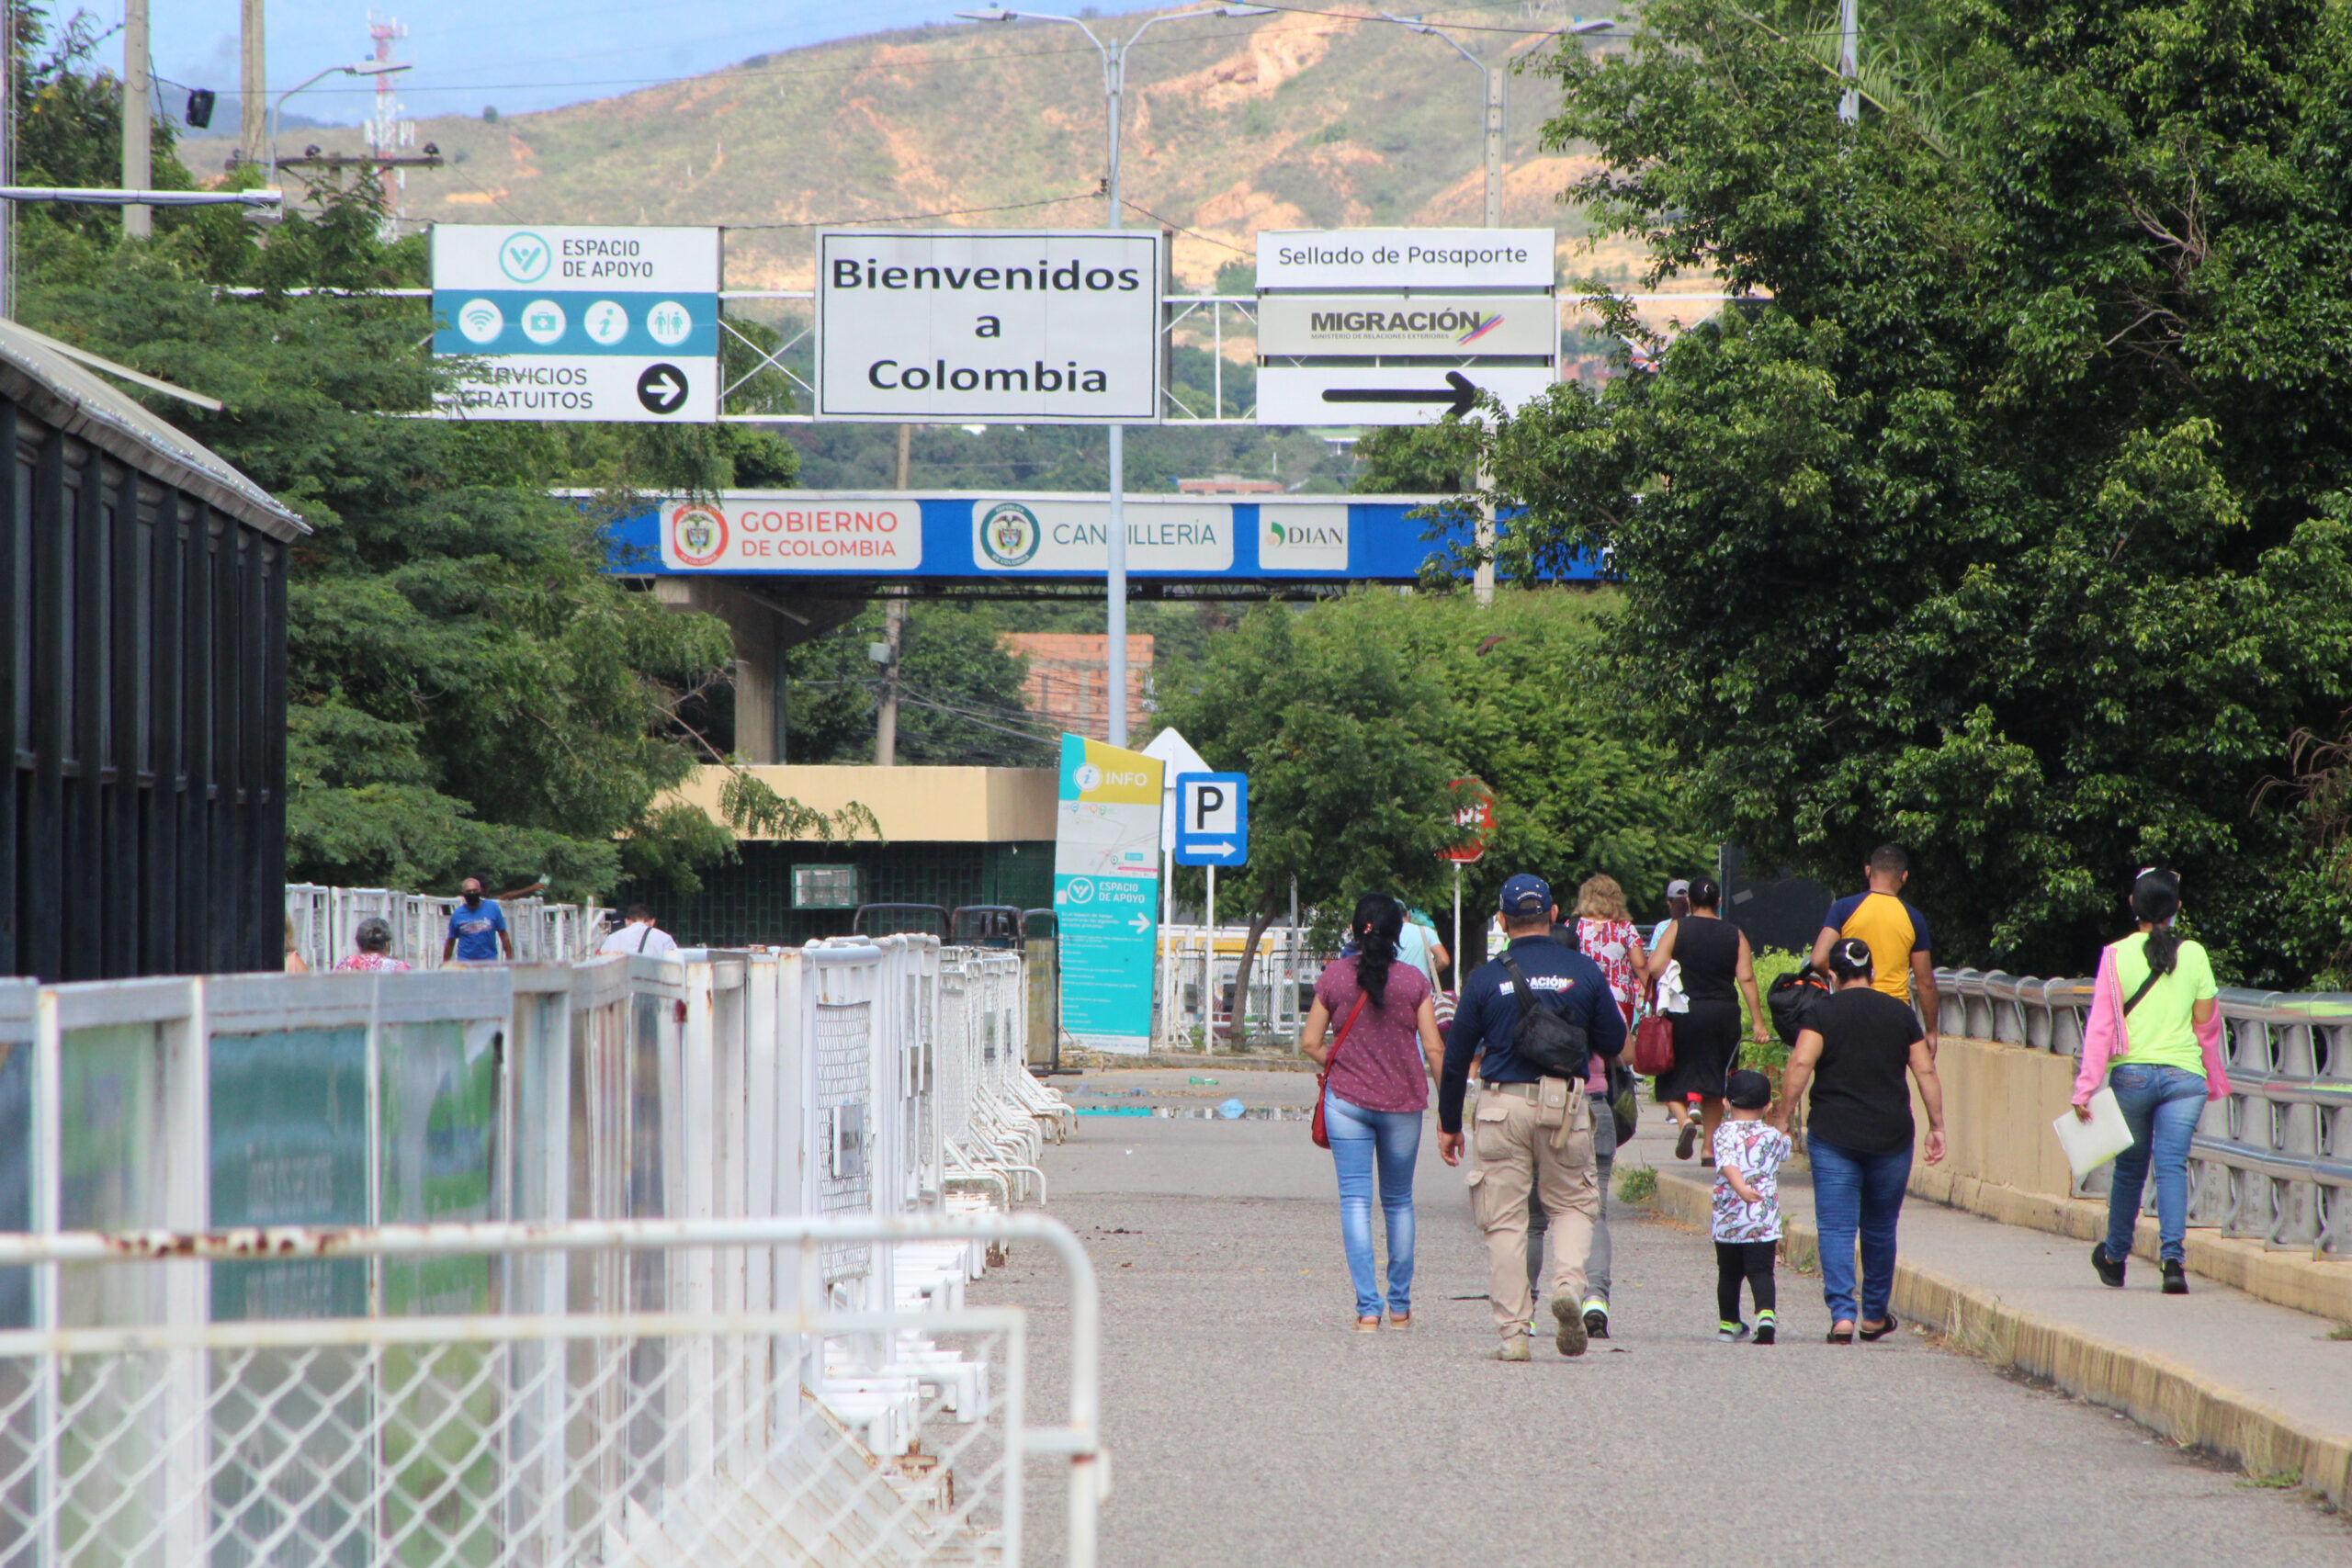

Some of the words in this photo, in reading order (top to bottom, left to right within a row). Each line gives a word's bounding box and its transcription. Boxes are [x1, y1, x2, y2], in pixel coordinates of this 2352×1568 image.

[562, 240, 640, 256] ESPACIO
[1279, 246, 1364, 265] Sellado
[1372, 246, 1399, 264] de
[1408, 246, 1528, 268] Pasaporte
[562, 261, 586, 276] DE
[592, 261, 653, 277] APOYO
[832, 258, 1140, 291] Bienvenidos
[975, 315, 1001, 338] a
[1311, 308, 1480, 332] MIGRACIÓN
[867, 359, 1107, 393] Colombia
[741, 511, 898, 533] GOBIERNO
[1053, 518, 1216, 546] CANILLERÍA
[1288, 526, 1343, 545] DIAN
[741, 540, 771, 557] DE
[777, 539, 897, 557] COLOMBIA
[1105, 772, 1148, 787] INFO
[1196, 786, 1224, 830] P
[1099, 882, 1139, 893] ESPACIO
[1098, 892, 1111, 901] DE
[1113, 893, 1146, 904] APOYO
[1498, 975, 1568, 993] MIACIÓN
